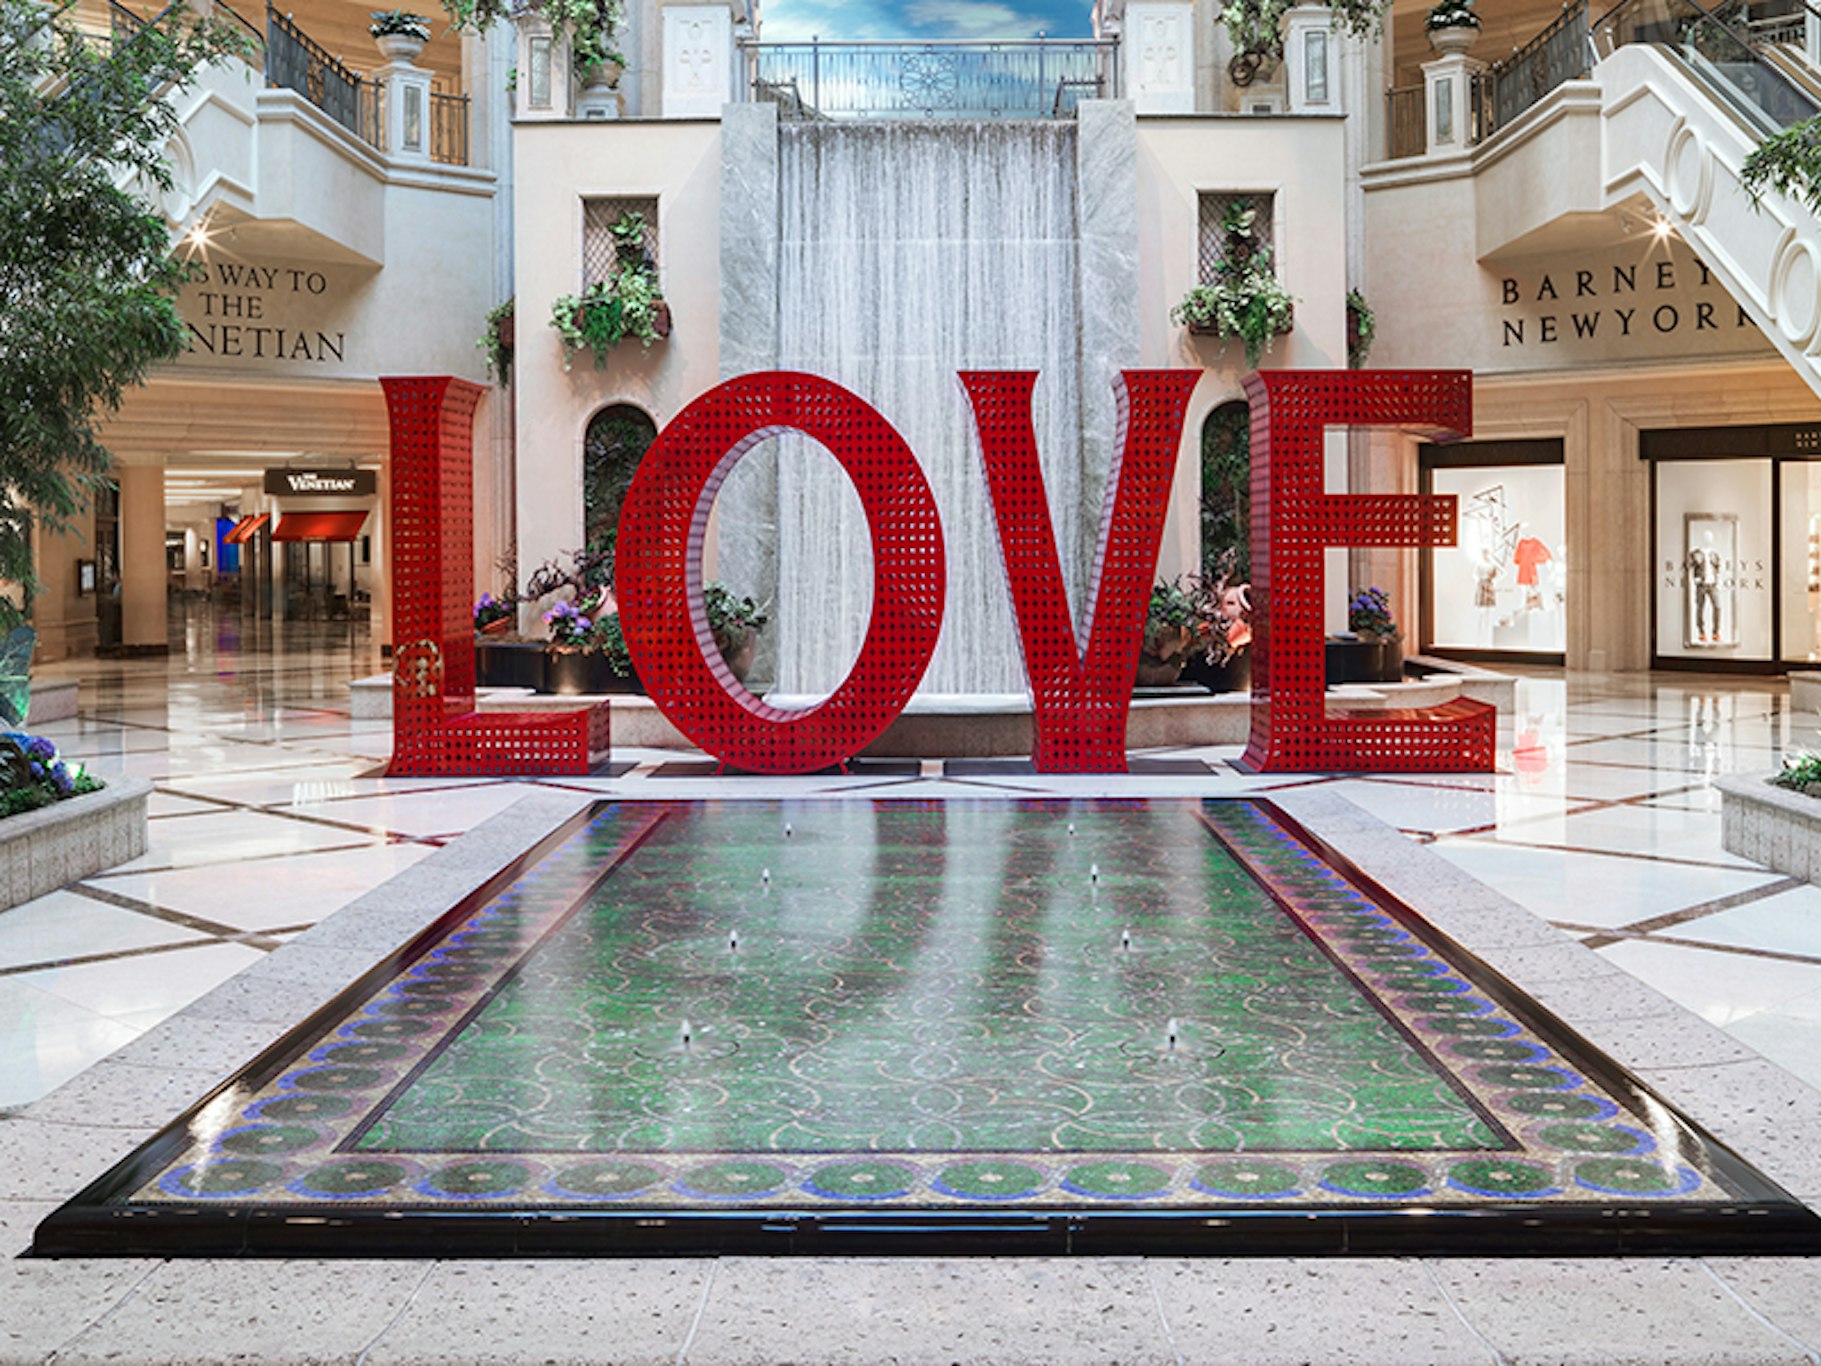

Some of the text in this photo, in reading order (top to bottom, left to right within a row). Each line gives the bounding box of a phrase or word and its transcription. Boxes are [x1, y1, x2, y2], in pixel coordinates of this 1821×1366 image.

[218, 264, 279, 289] WAY
[287, 270, 326, 295] TO
[1502, 258, 1710, 305] BARNEY
[199, 292, 264, 320] THE
[186, 323, 345, 363] NETIAN
[379, 371, 1497, 774] LOVE
